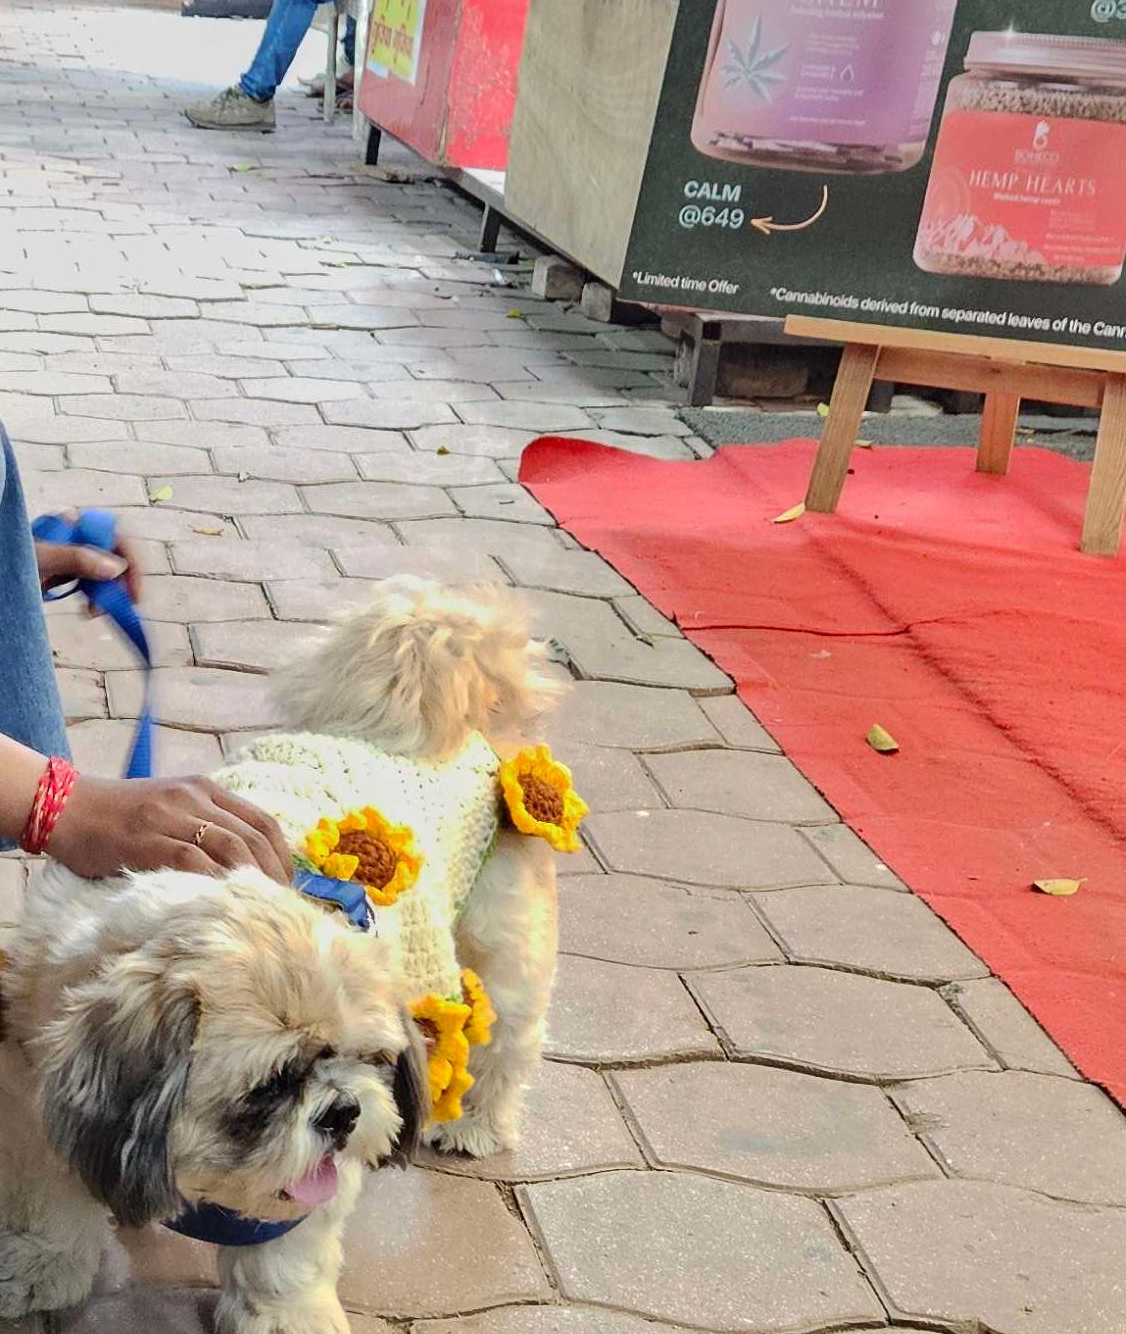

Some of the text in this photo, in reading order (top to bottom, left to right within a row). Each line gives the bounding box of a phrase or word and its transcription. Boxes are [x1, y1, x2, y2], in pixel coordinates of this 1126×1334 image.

[684, 179, 742, 203] CALM
[969, 170, 1097, 197] HEMP HEARTS
[678, 205, 745, 230] @649
[681, 277, 706, 292] time
[707, 279, 740, 295] Offer
[860, 297, 908, 315] derived
[909, 301, 941, 318] from
[941, 306, 1006, 327] separated
[1007, 312, 1050, 331] leaves
[1052, 317, 1068, 332] of
[1069, 318, 1091, 336] the
